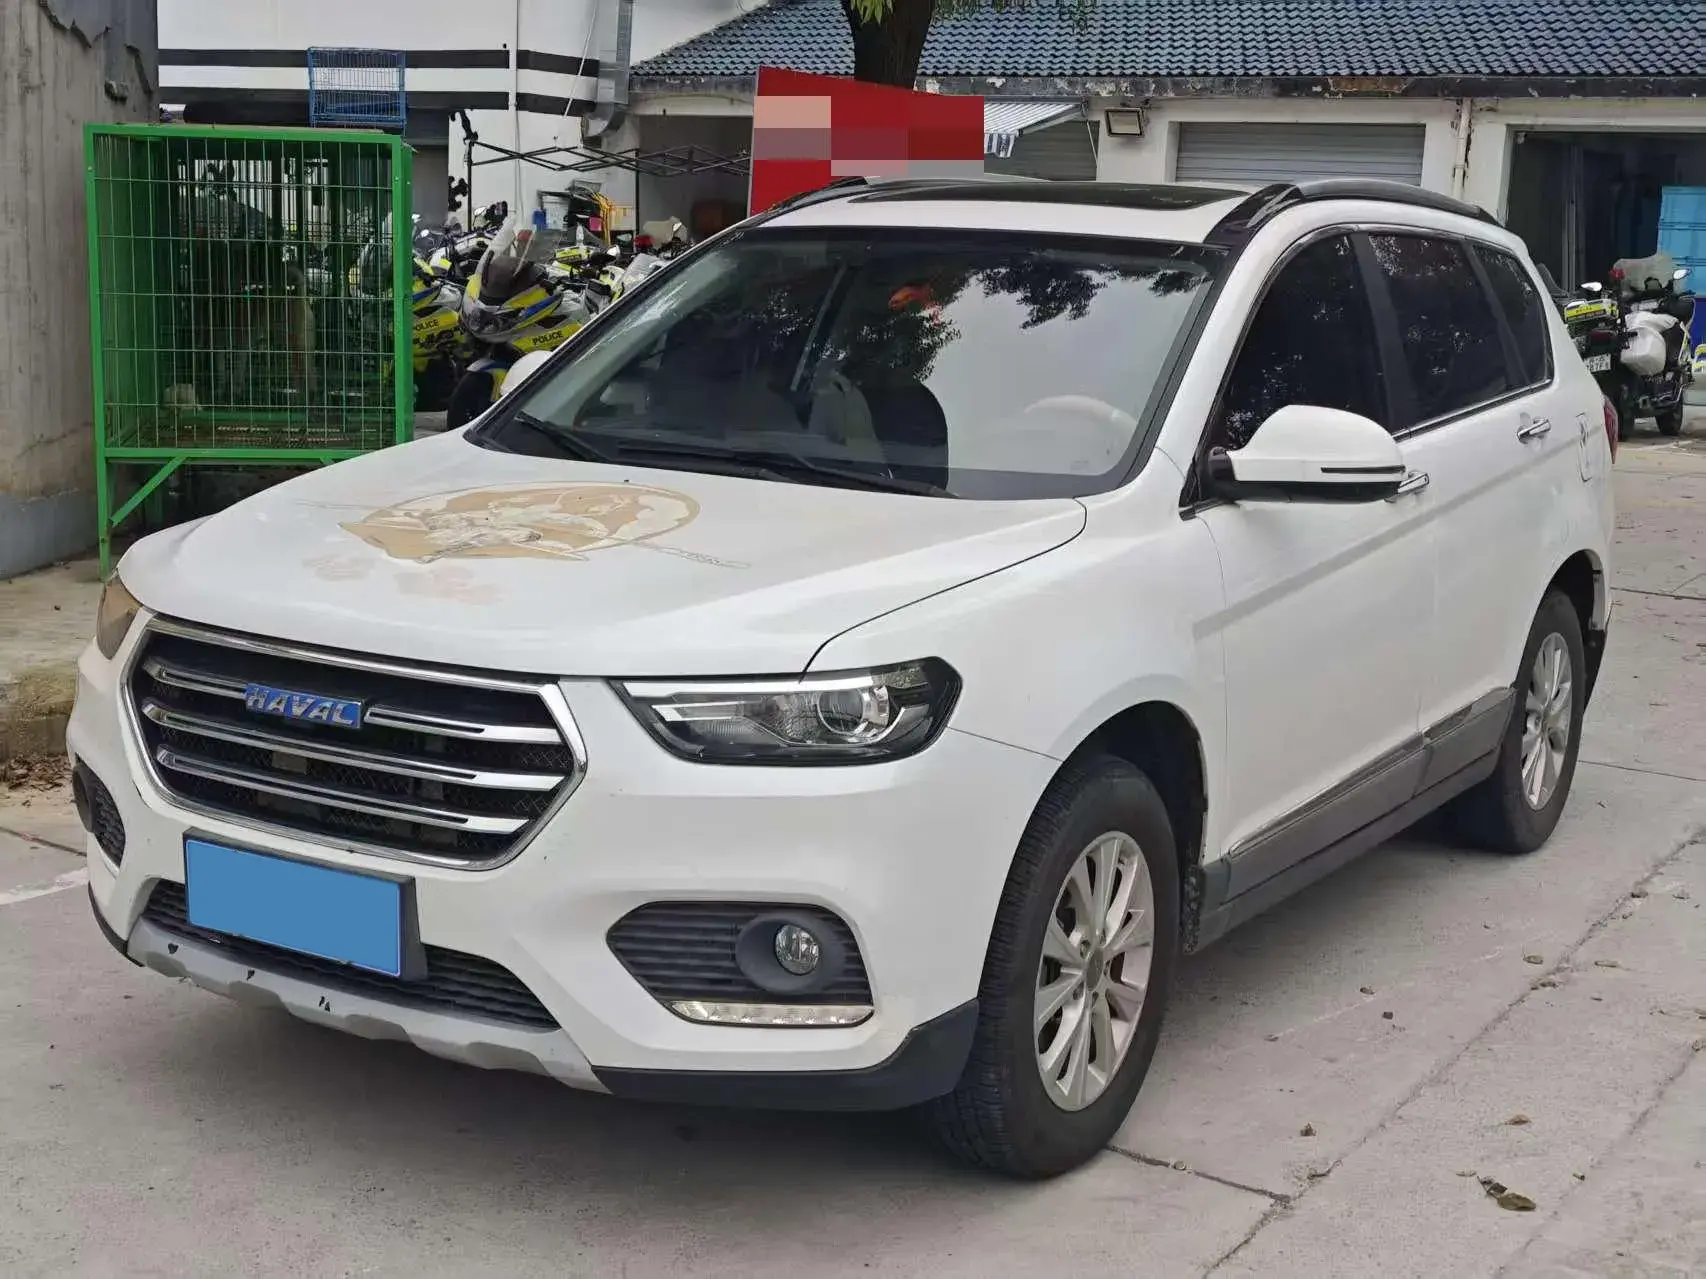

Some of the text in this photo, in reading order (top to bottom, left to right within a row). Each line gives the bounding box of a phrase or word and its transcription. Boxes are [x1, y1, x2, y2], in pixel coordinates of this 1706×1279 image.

[414, 319, 439, 330] OLICE
[532, 331, 563, 345] POLICE
[246, 686, 355, 725] HAVAL
